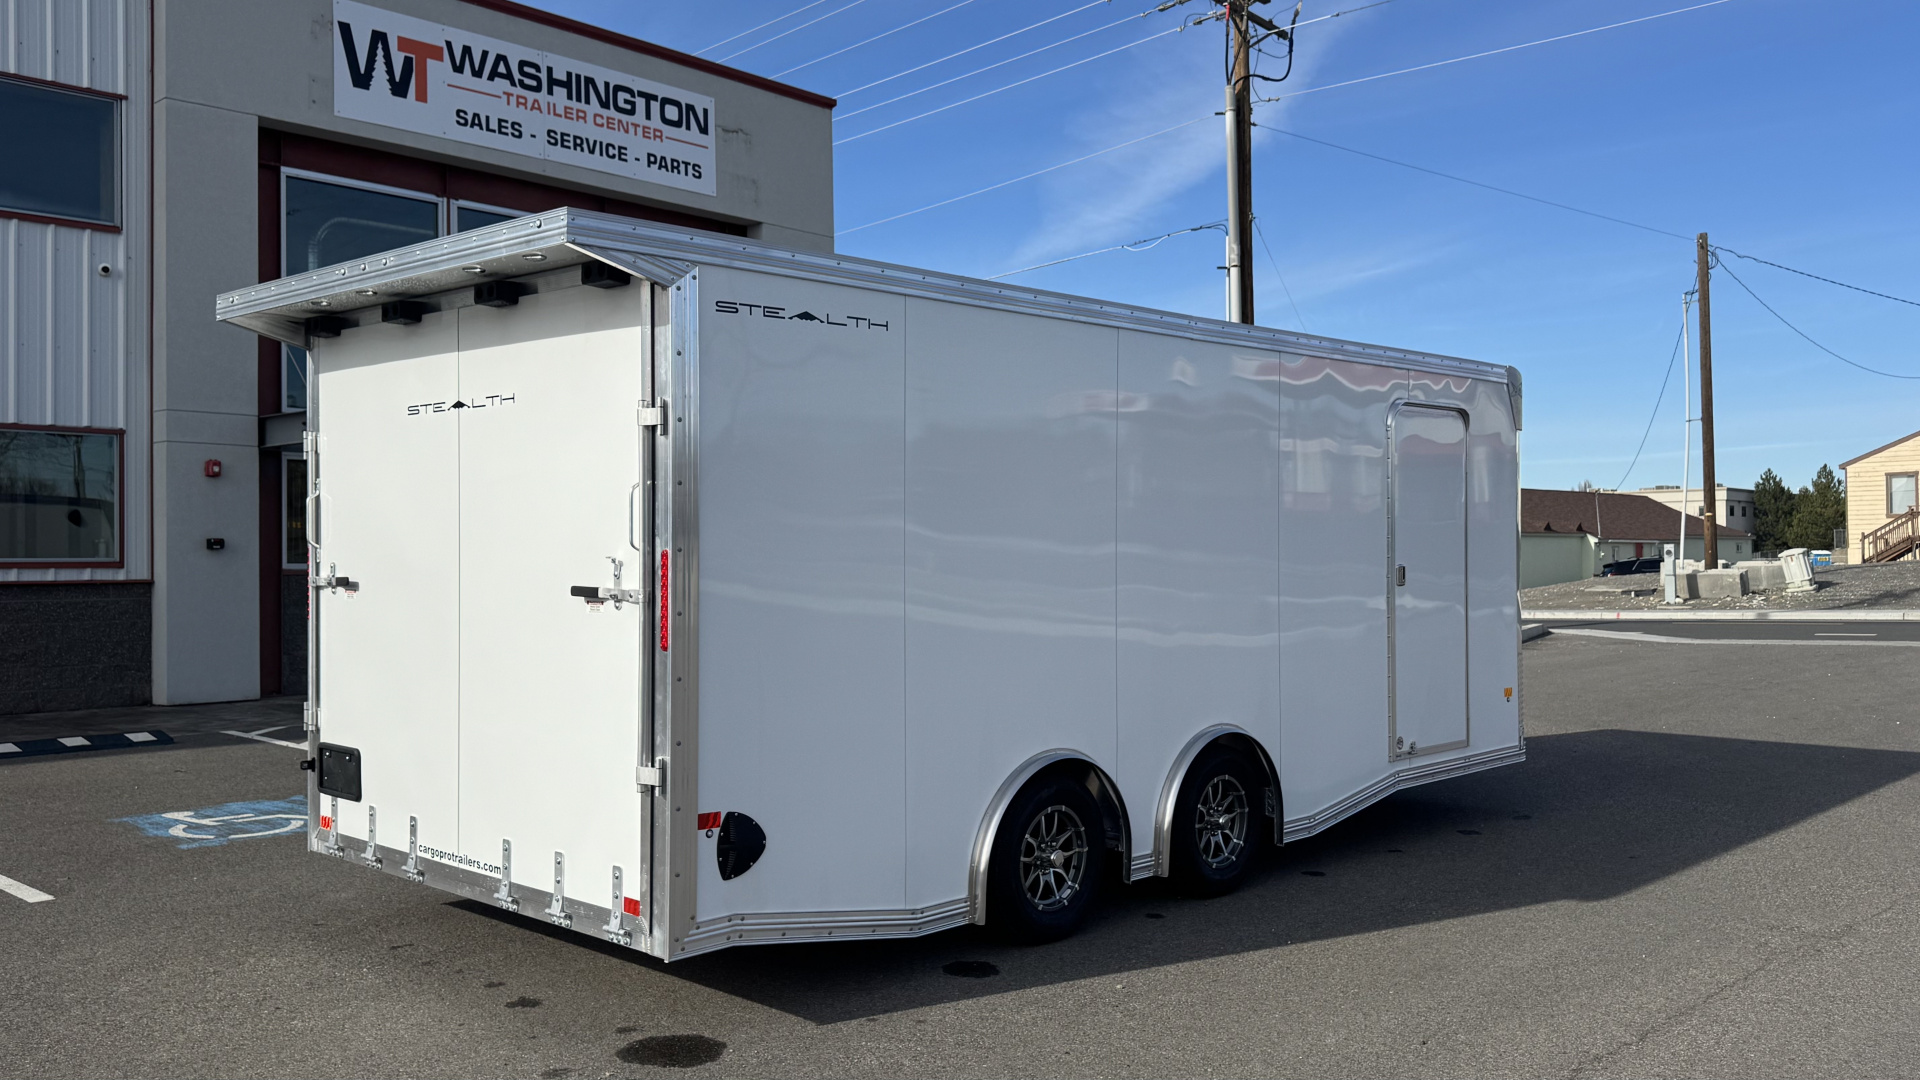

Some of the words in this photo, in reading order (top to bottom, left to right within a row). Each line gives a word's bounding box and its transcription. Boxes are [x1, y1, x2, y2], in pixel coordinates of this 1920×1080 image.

[337, 20, 444, 104] WT
[444, 39, 709, 136] WASHINGTON
[502, 91, 588, 124] TRAILER
[593, 113, 664, 143] CENTER
[455, 108, 523, 139] SALES
[546, 128, 628, 163] SERVICE
[646, 152, 703, 180] PARTS
[715, 300, 889, 332] STEALTH
[407, 392, 515, 416] STEALTH
[418, 844, 502, 875] cargoprotrailers.com
